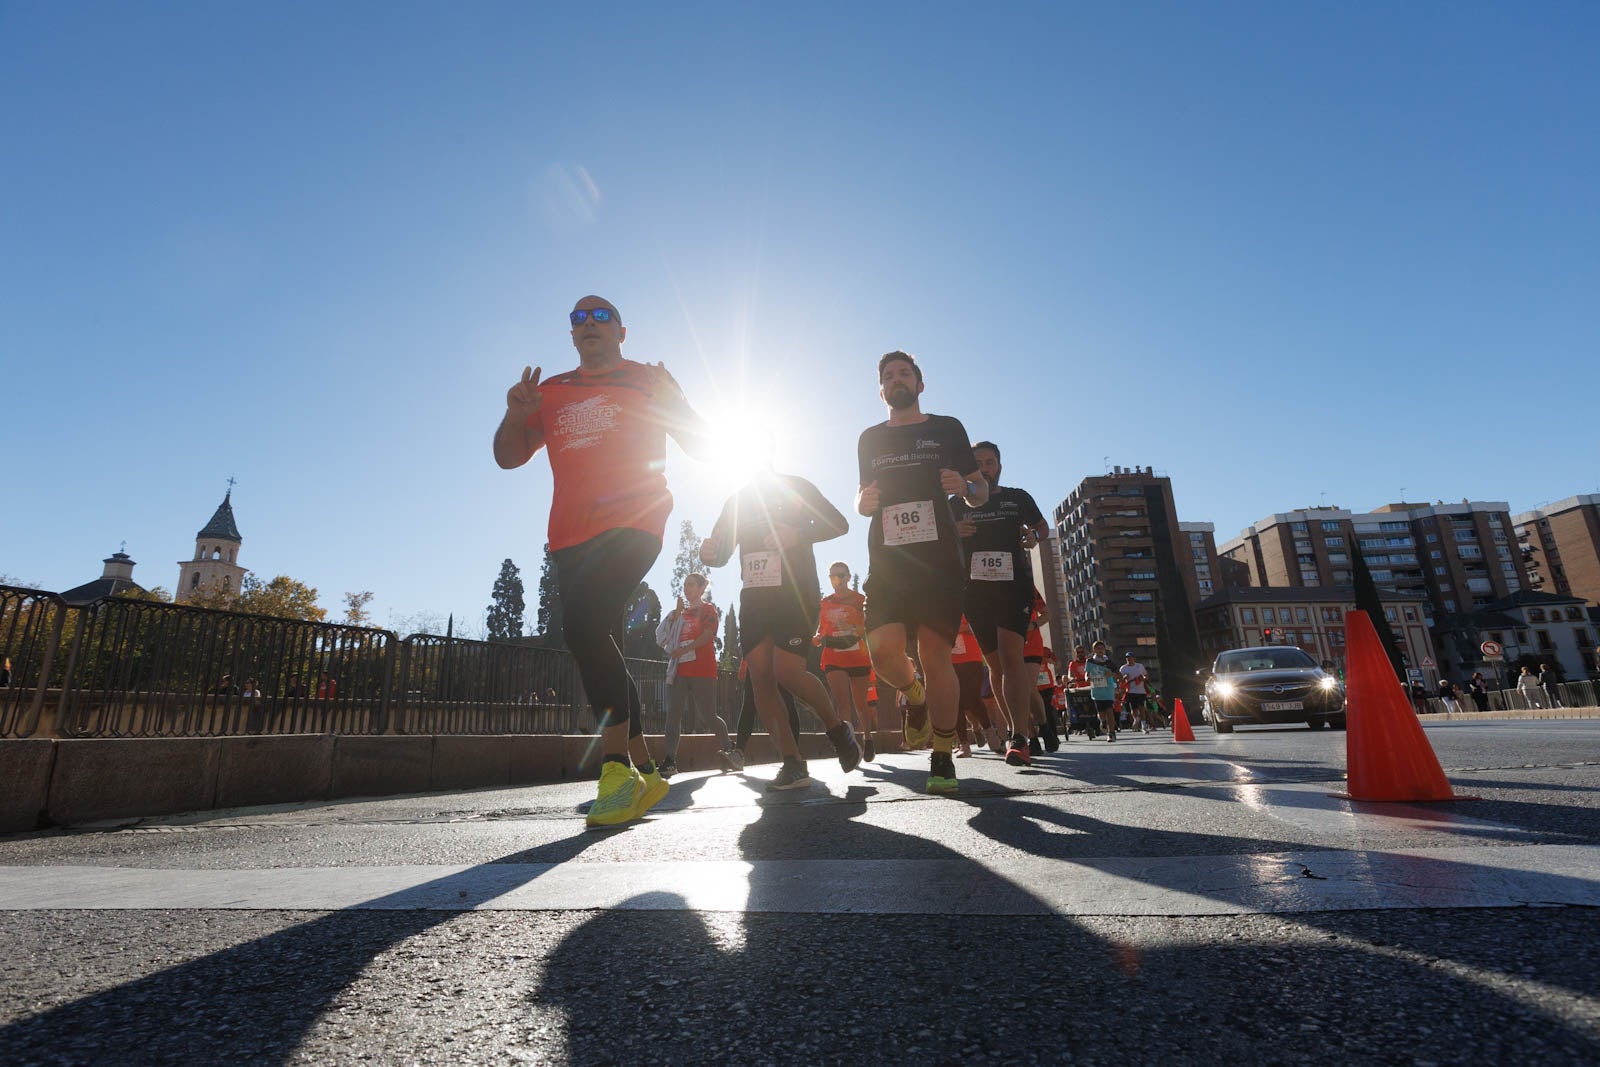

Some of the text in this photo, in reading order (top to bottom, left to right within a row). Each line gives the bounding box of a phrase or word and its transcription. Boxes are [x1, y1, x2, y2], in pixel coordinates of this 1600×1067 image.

[558, 407, 614, 425] carrera
[893, 511, 920, 526] 186
[748, 559, 768, 571] 187
[981, 558, 1002, 567] 185
